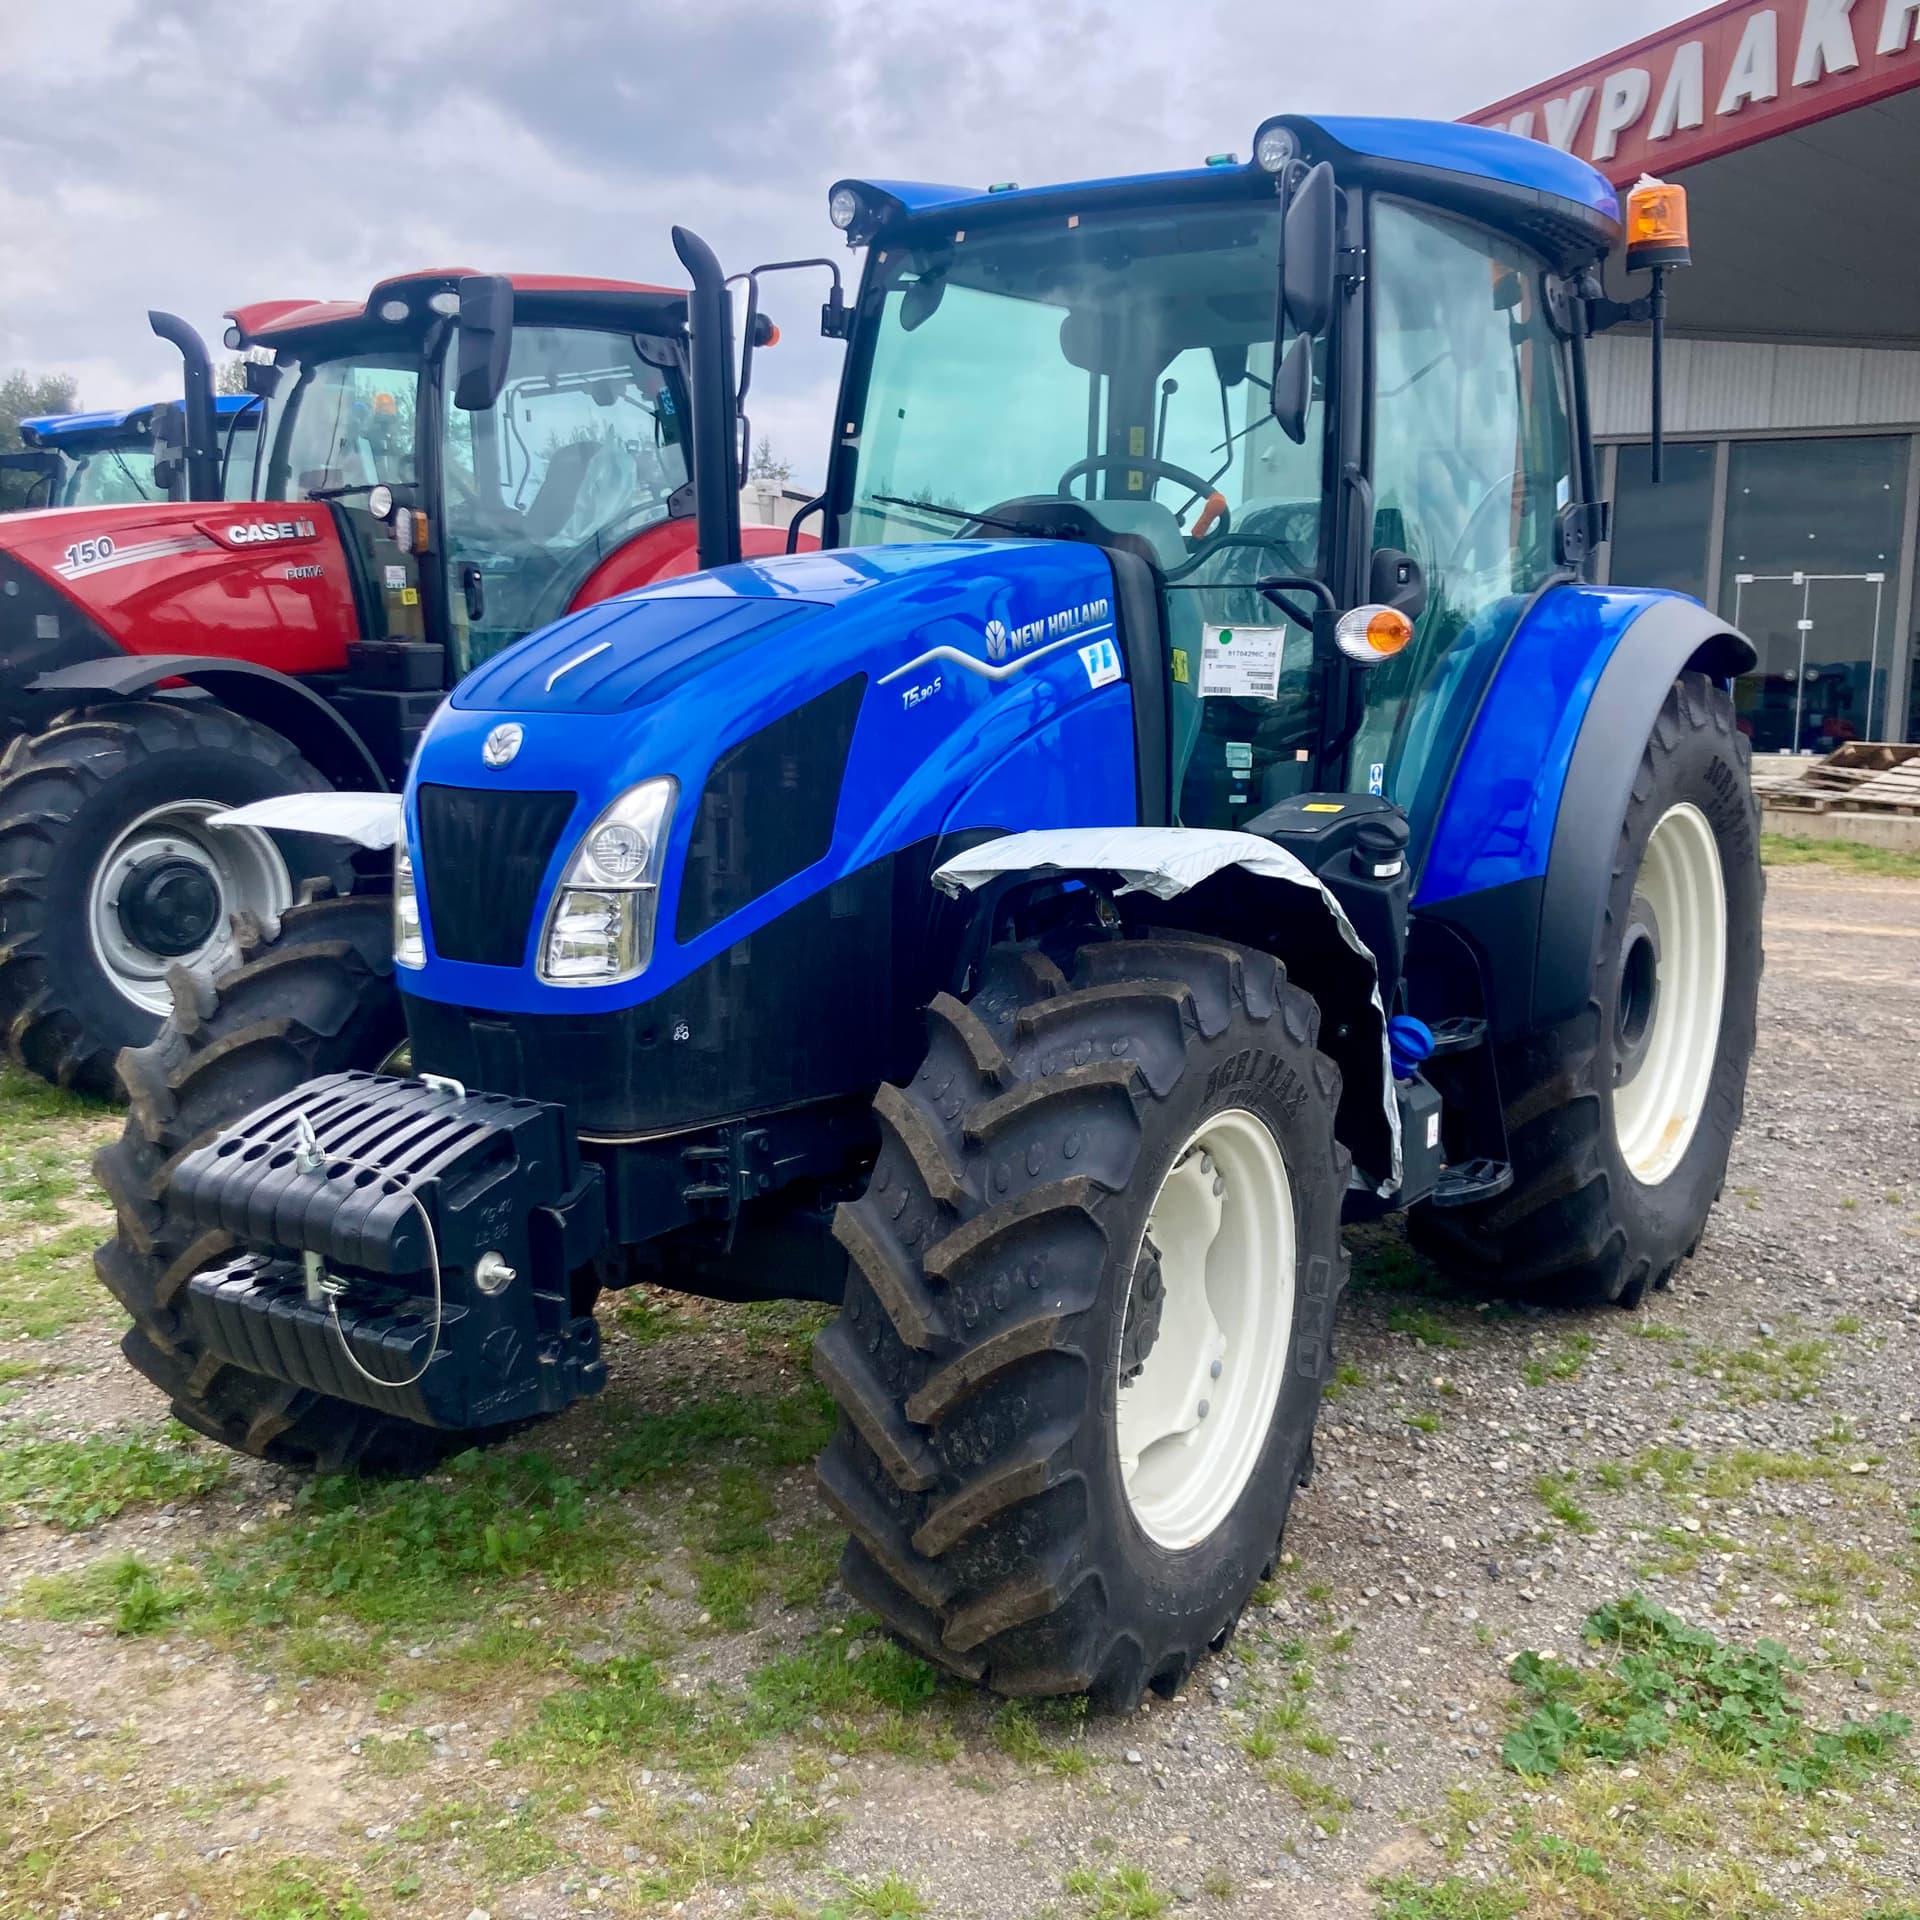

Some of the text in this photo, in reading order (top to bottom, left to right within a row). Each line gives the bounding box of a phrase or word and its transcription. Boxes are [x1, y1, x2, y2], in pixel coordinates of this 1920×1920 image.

[1489, 0, 1920, 162] ΥΡΛΑΚ
[228, 523, 295, 544] CASE
[66, 537, 114, 568] 150
[285, 565, 323, 580] PUMA
[1010, 598, 1109, 652] NEW HOLLAND
